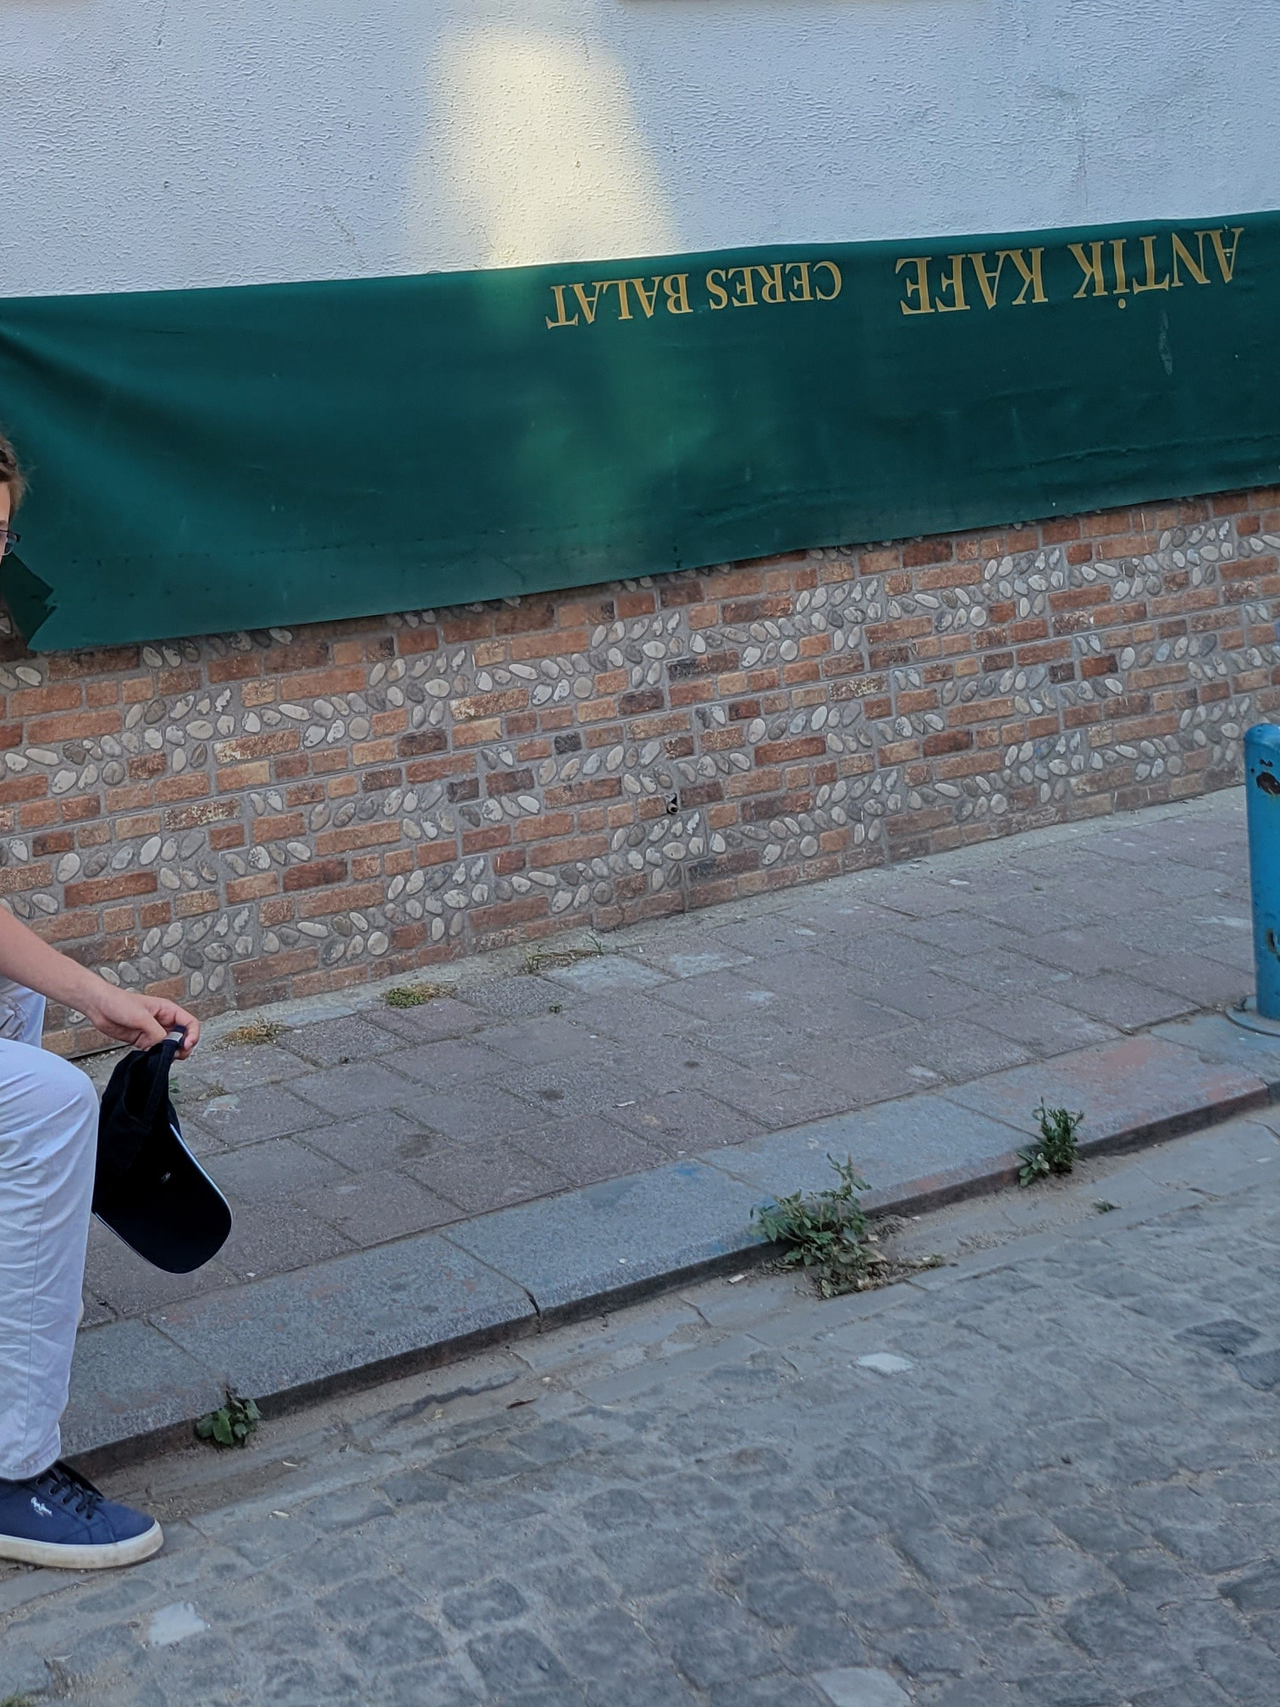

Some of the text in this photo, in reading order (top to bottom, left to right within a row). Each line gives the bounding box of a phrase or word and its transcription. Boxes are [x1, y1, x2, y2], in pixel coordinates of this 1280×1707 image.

[545, 227, 1245, 330] ANTİK KAFE CERES BALAT
